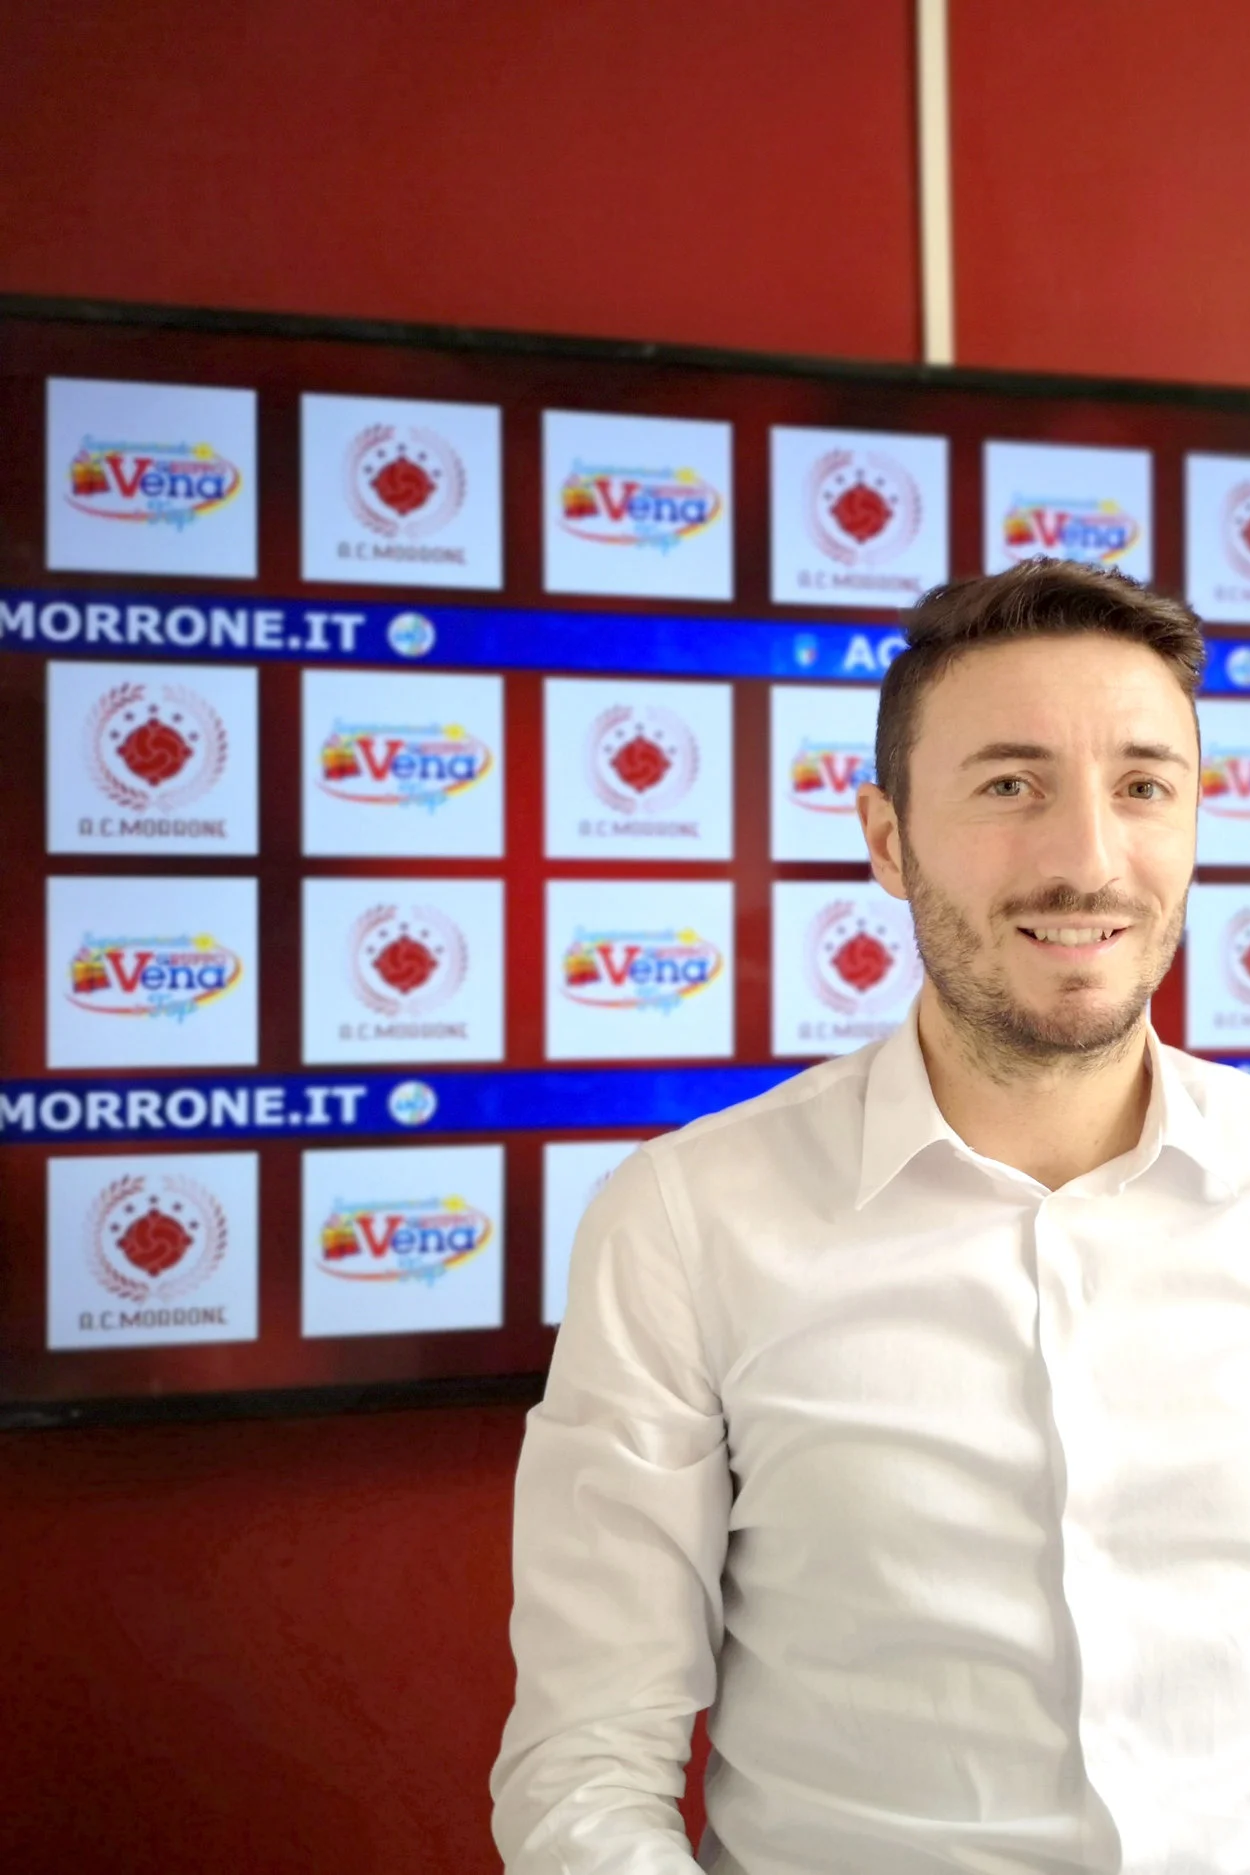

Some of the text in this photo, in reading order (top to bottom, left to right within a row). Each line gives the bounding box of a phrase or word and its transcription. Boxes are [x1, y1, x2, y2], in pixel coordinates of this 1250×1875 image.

[105, 453, 226, 500] Vena
[595, 477, 708, 525] Vena
[1031, 509, 1126, 551] Vena
[0, 602, 366, 652] MORRONE.IT
[356, 736, 477, 781] Vena
[105, 950, 227, 994] Vena
[596, 944, 710, 986] Vena
[0, 1086, 367, 1132] MORRONE.IT
[356, 1213, 478, 1259] Vena
